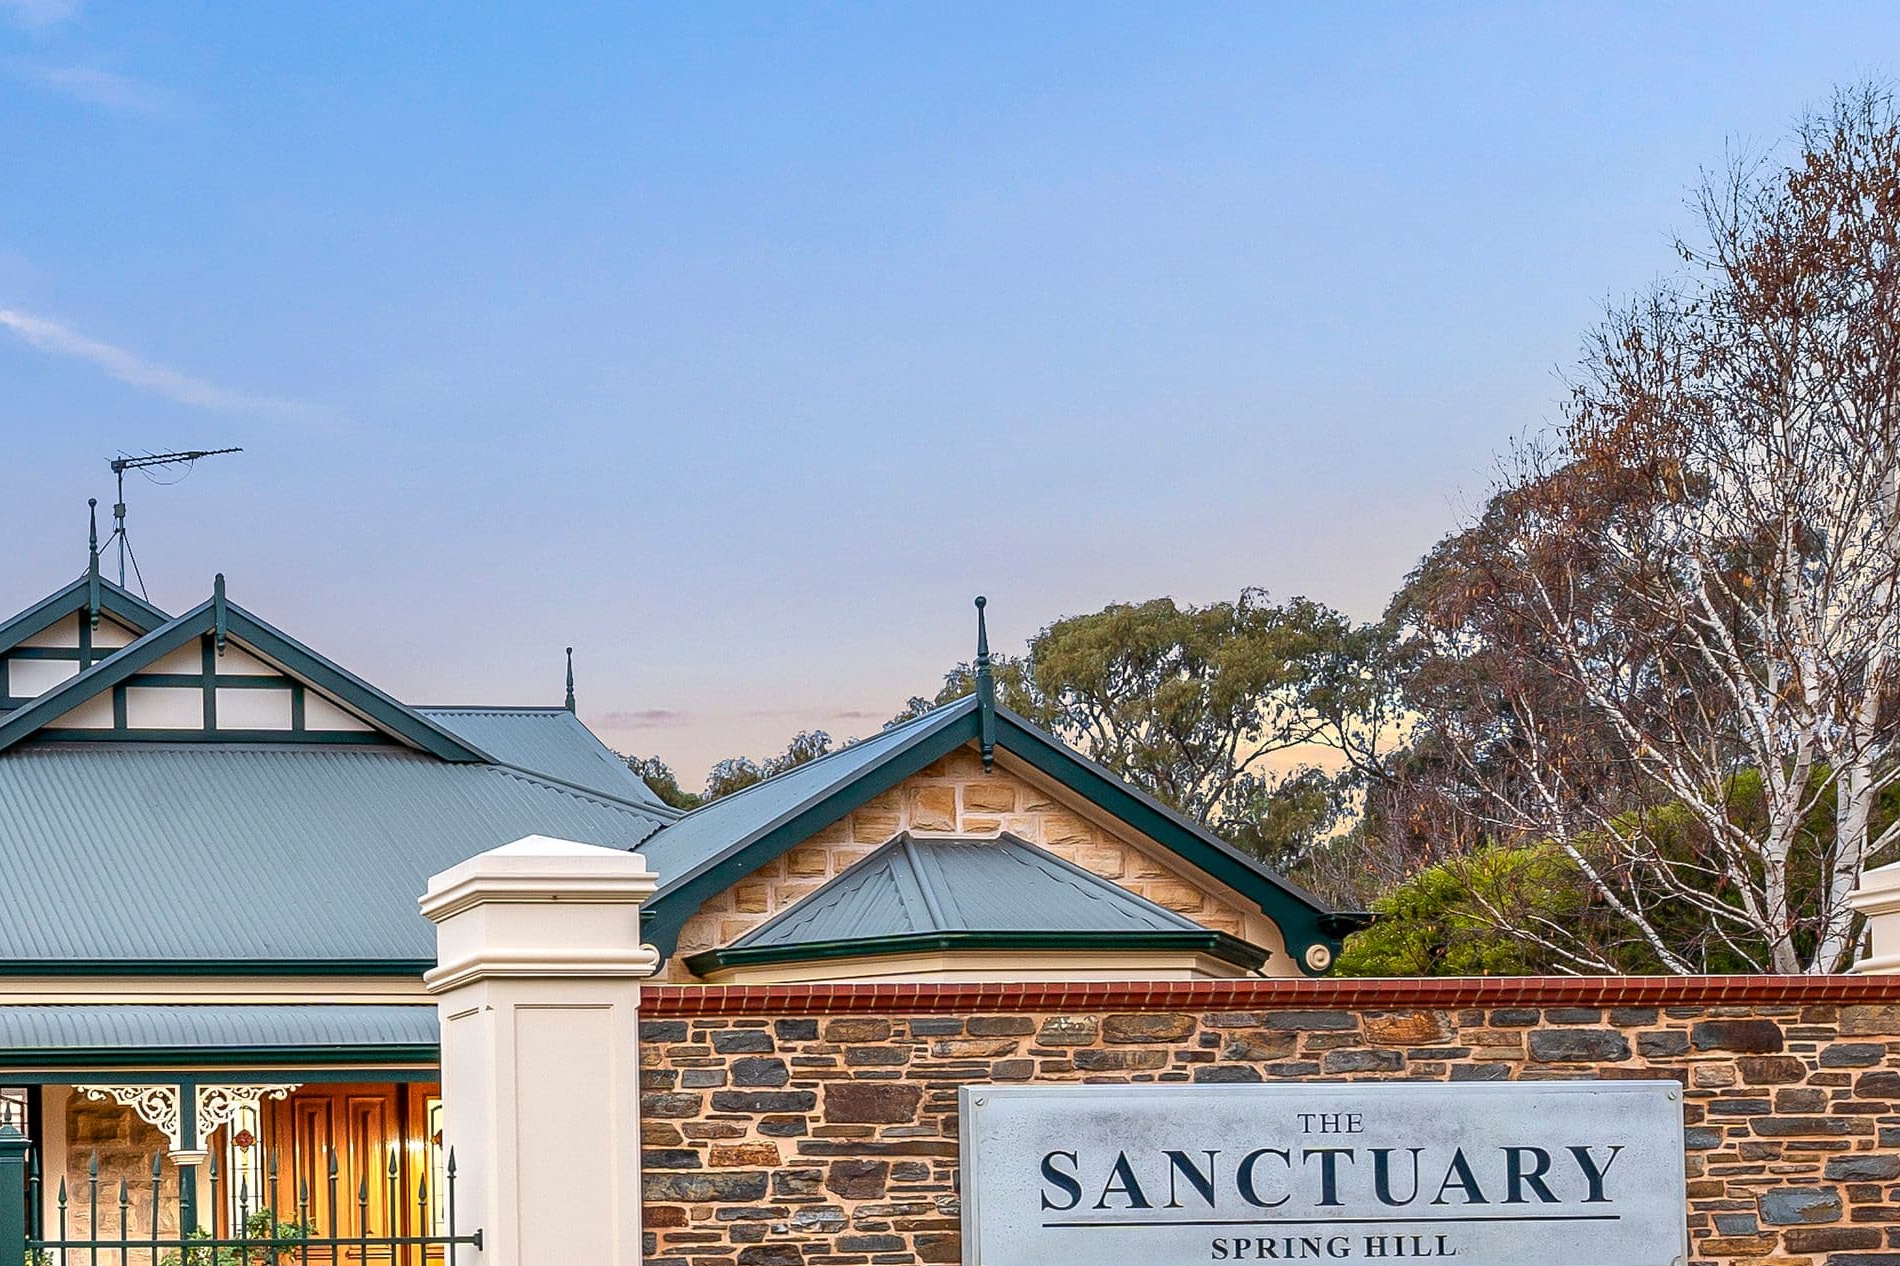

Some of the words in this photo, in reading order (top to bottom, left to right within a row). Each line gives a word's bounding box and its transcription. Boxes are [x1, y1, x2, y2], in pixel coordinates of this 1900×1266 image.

[1297, 1112, 1364, 1135] THE
[1040, 1145, 1623, 1211] SANCTUARY
[1211, 1236, 1352, 1261] SPRING
[1363, 1234, 1458, 1258] HILL
